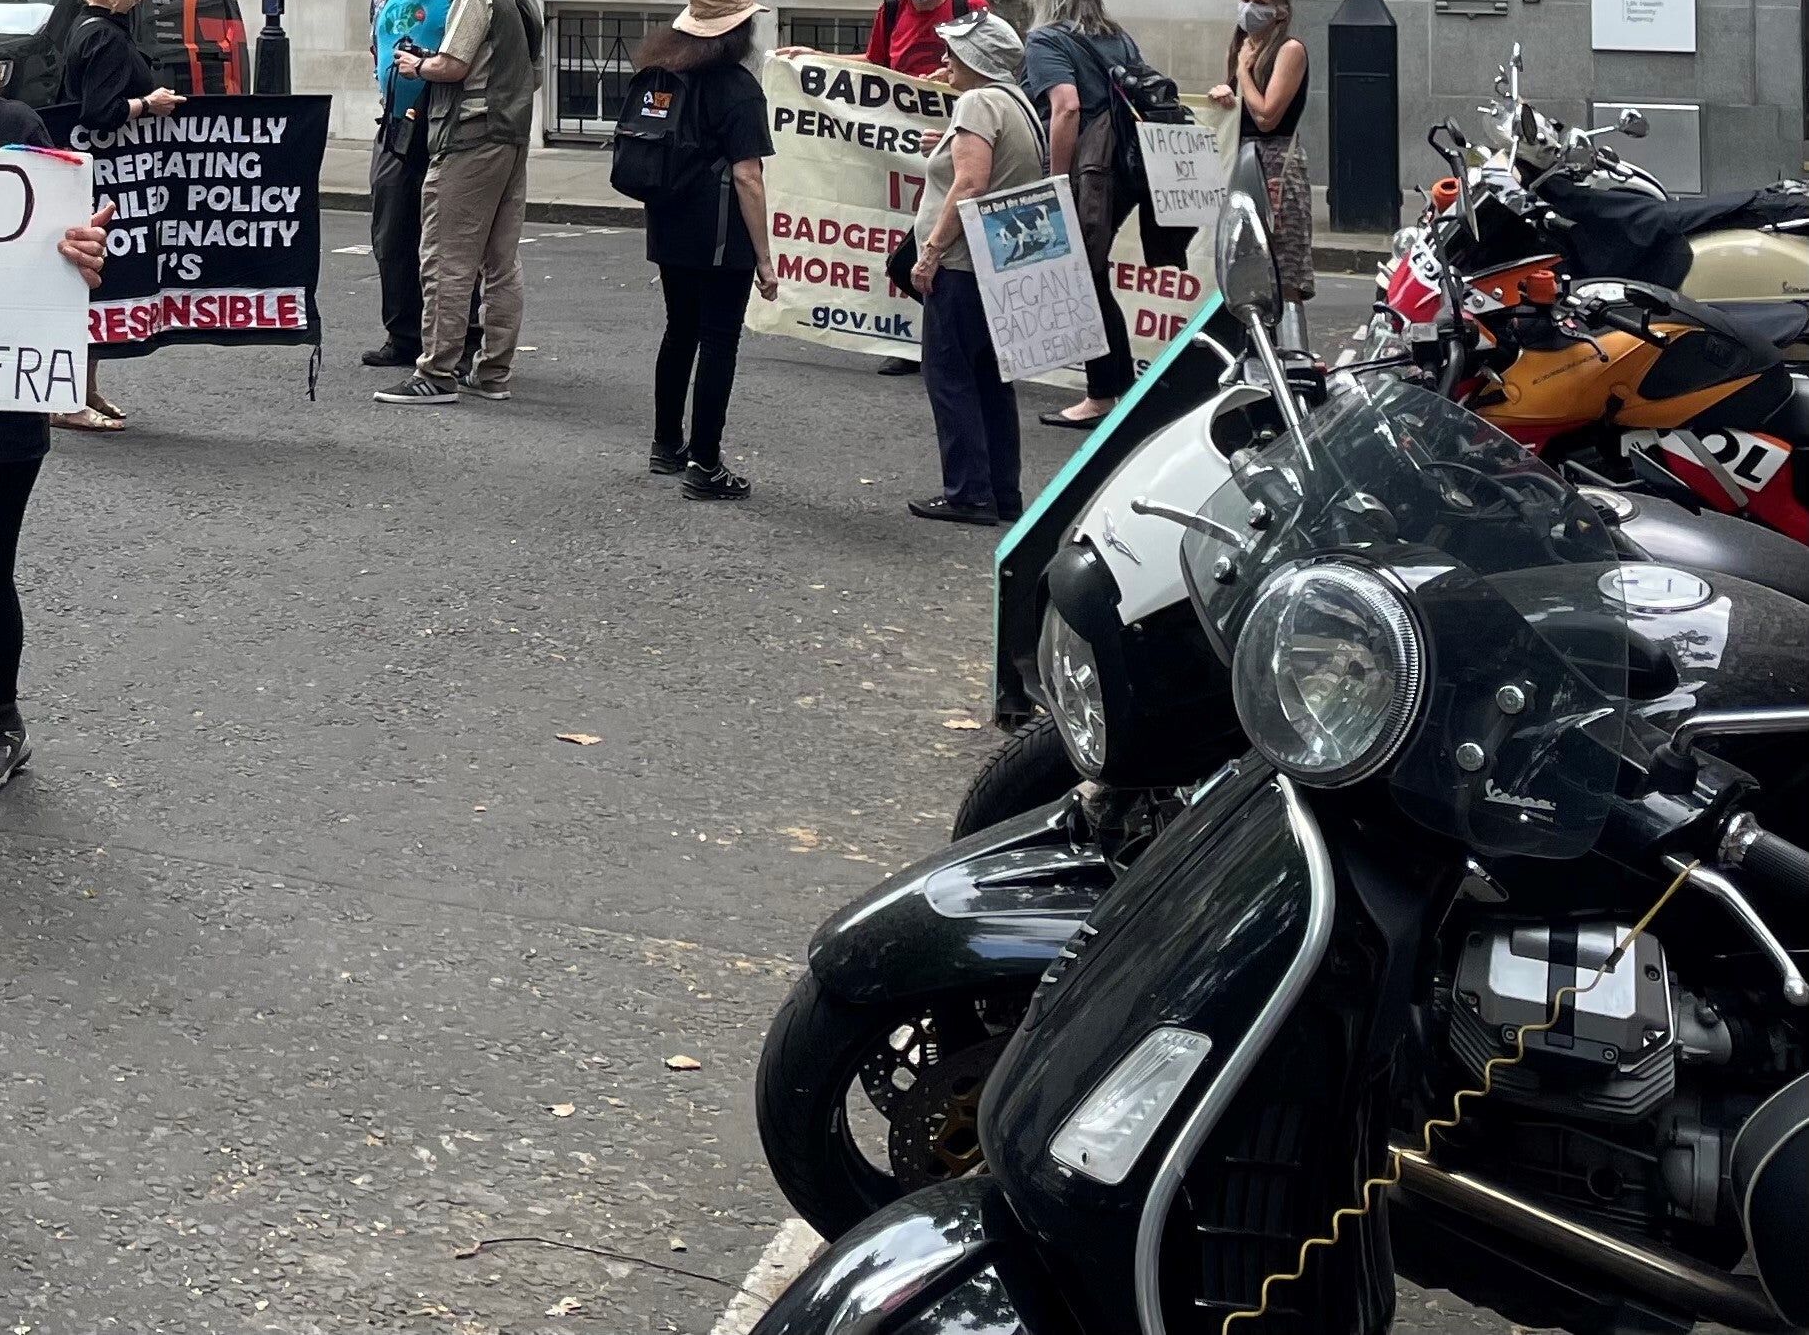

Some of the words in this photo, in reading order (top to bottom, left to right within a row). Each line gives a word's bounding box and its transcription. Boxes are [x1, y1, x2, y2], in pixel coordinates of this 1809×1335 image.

[1143, 128, 1219, 155] VACCINATE
[93, 151, 262, 186] REPEATING
[1174, 160, 1196, 178] NOT
[92, 185, 170, 220] AILED
[187, 185, 301, 213] POLICY
[102, 226, 148, 257] OT
[777, 253, 870, 293] MORE
[987, 266, 1072, 315] VEGAN
[1108, 260, 1202, 303] ERED
[811, 305, 913, 339] gov.uk
[991, 294, 1097, 348] BADGERS
[1041, 323, 1101, 364] BEINGS
